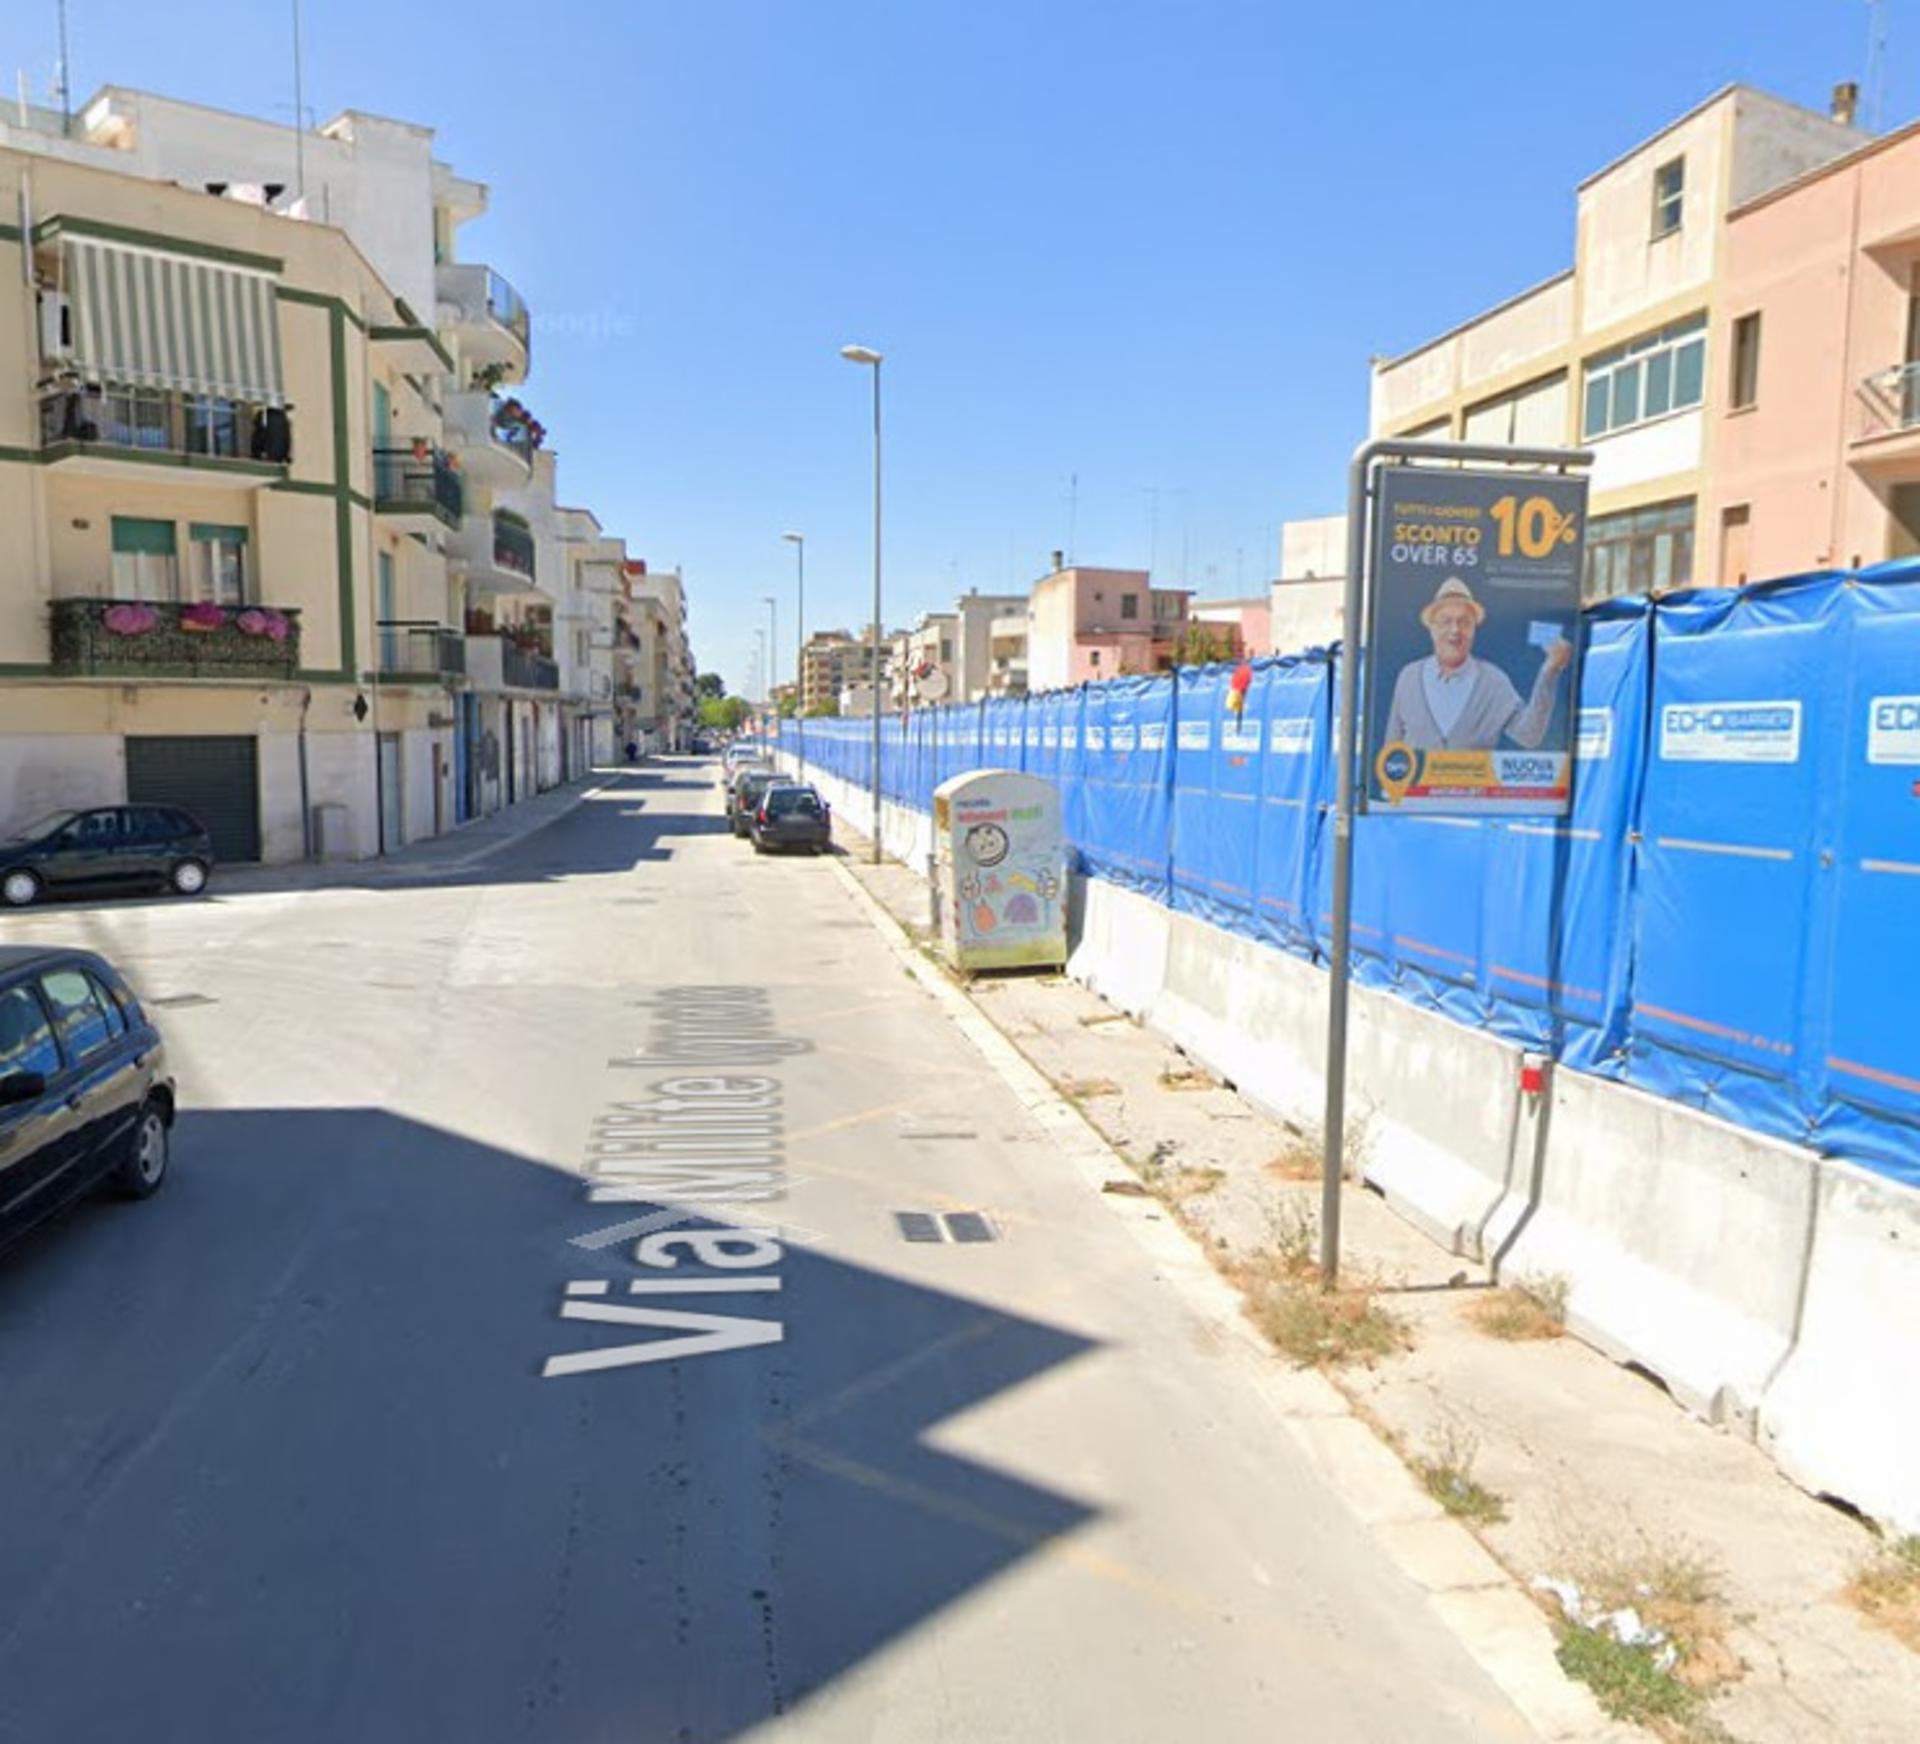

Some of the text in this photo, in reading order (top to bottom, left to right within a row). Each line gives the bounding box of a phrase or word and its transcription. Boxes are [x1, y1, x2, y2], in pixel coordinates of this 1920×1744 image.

[1394, 523, 1481, 545] SCONTO
[1490, 496, 1577, 558] 10%
[1391, 544, 1478, 566] OVER 65
